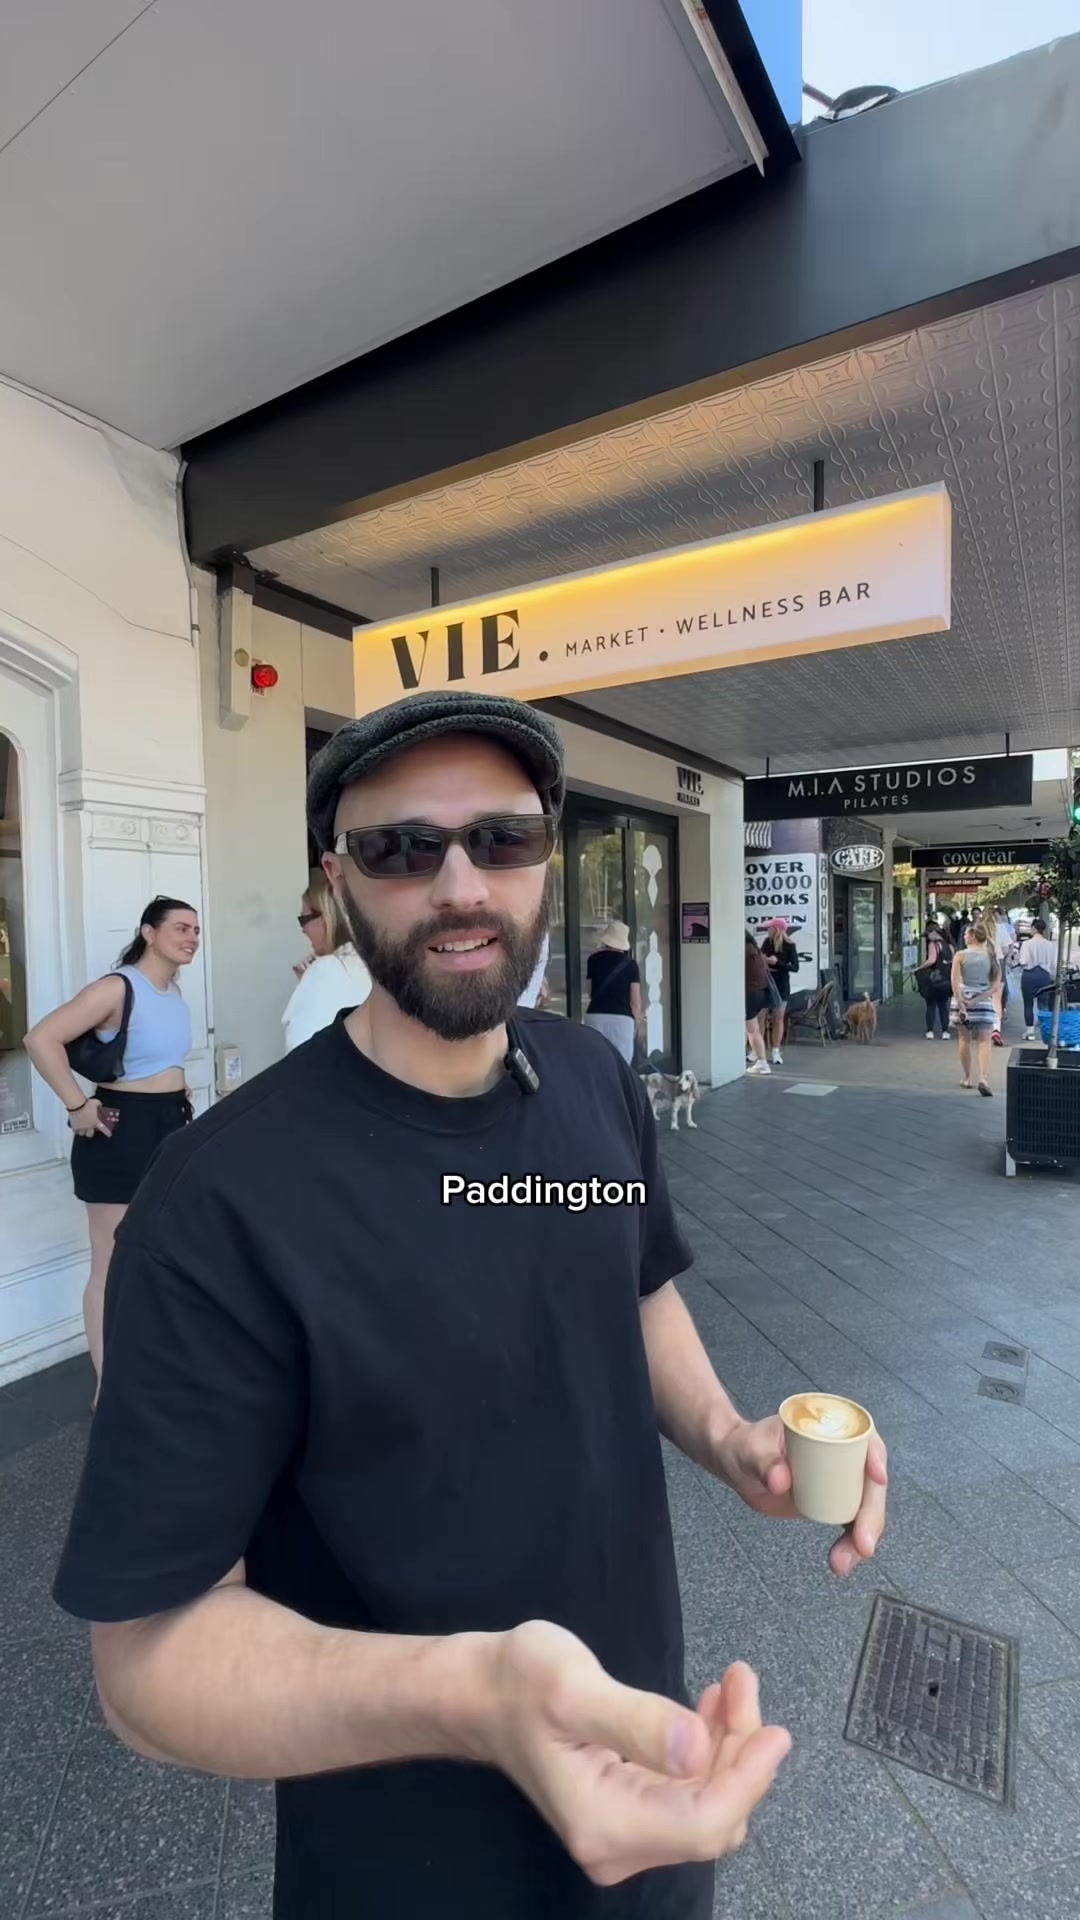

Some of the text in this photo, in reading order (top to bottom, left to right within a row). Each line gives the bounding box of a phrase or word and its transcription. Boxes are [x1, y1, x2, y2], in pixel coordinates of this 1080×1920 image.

[565, 626, 649, 658] MARKET
[675, 595, 804, 636] WELLNESS
[818, 581, 872, 608] BAR
[854, 766, 976, 793] STUDIOS
[844, 794, 909, 809] PILATES
[745, 861, 804, 875] OVER
[744, 893, 809, 906] BOOKS
[820, 858, 828, 945] BOOKS
